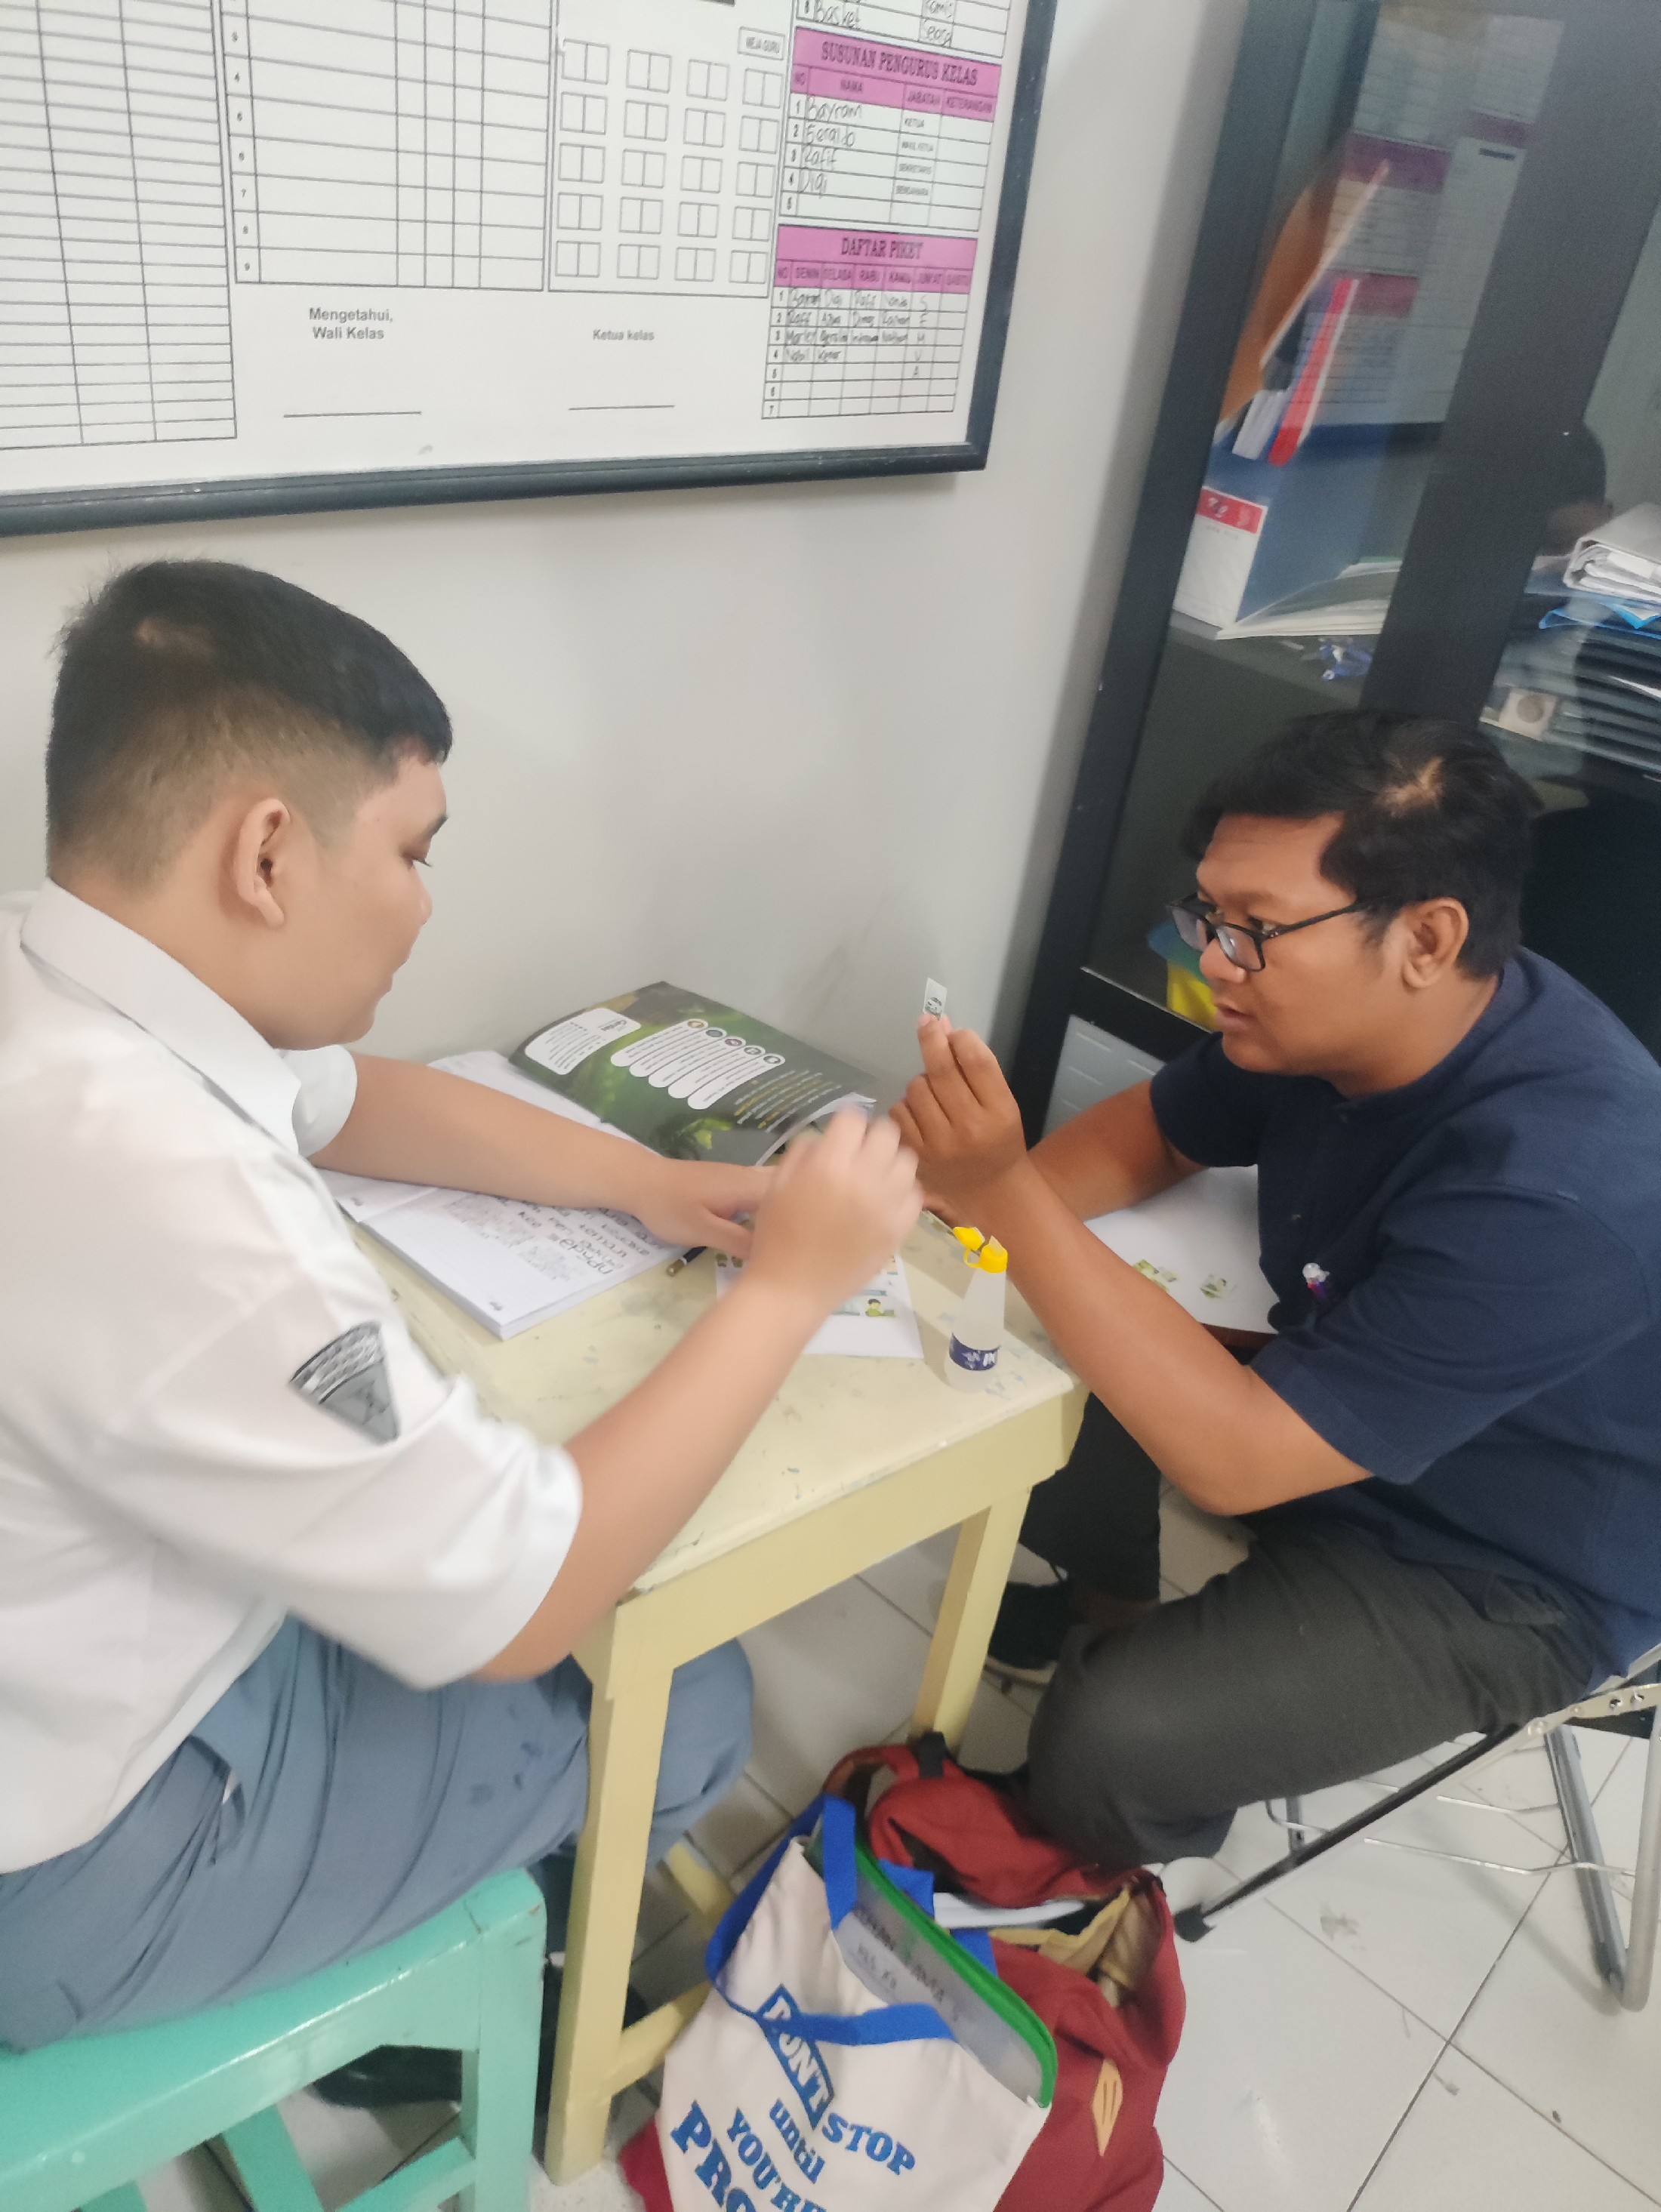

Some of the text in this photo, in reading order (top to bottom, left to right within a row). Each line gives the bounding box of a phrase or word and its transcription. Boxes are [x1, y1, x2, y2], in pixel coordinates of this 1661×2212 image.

[821, 40, 978, 86] SUSUNAN PENGURUS KELAS
[841, 237, 923, 260] DAFTAR PIKET
[309, 307, 393, 324] Mengetahui,
[312, 326, 384, 339] Wali Kelas
[593, 329, 655, 340] Ketua kelas
[769, 2096, 826, 2185] until
[821, 2112, 917, 2177] STOP
